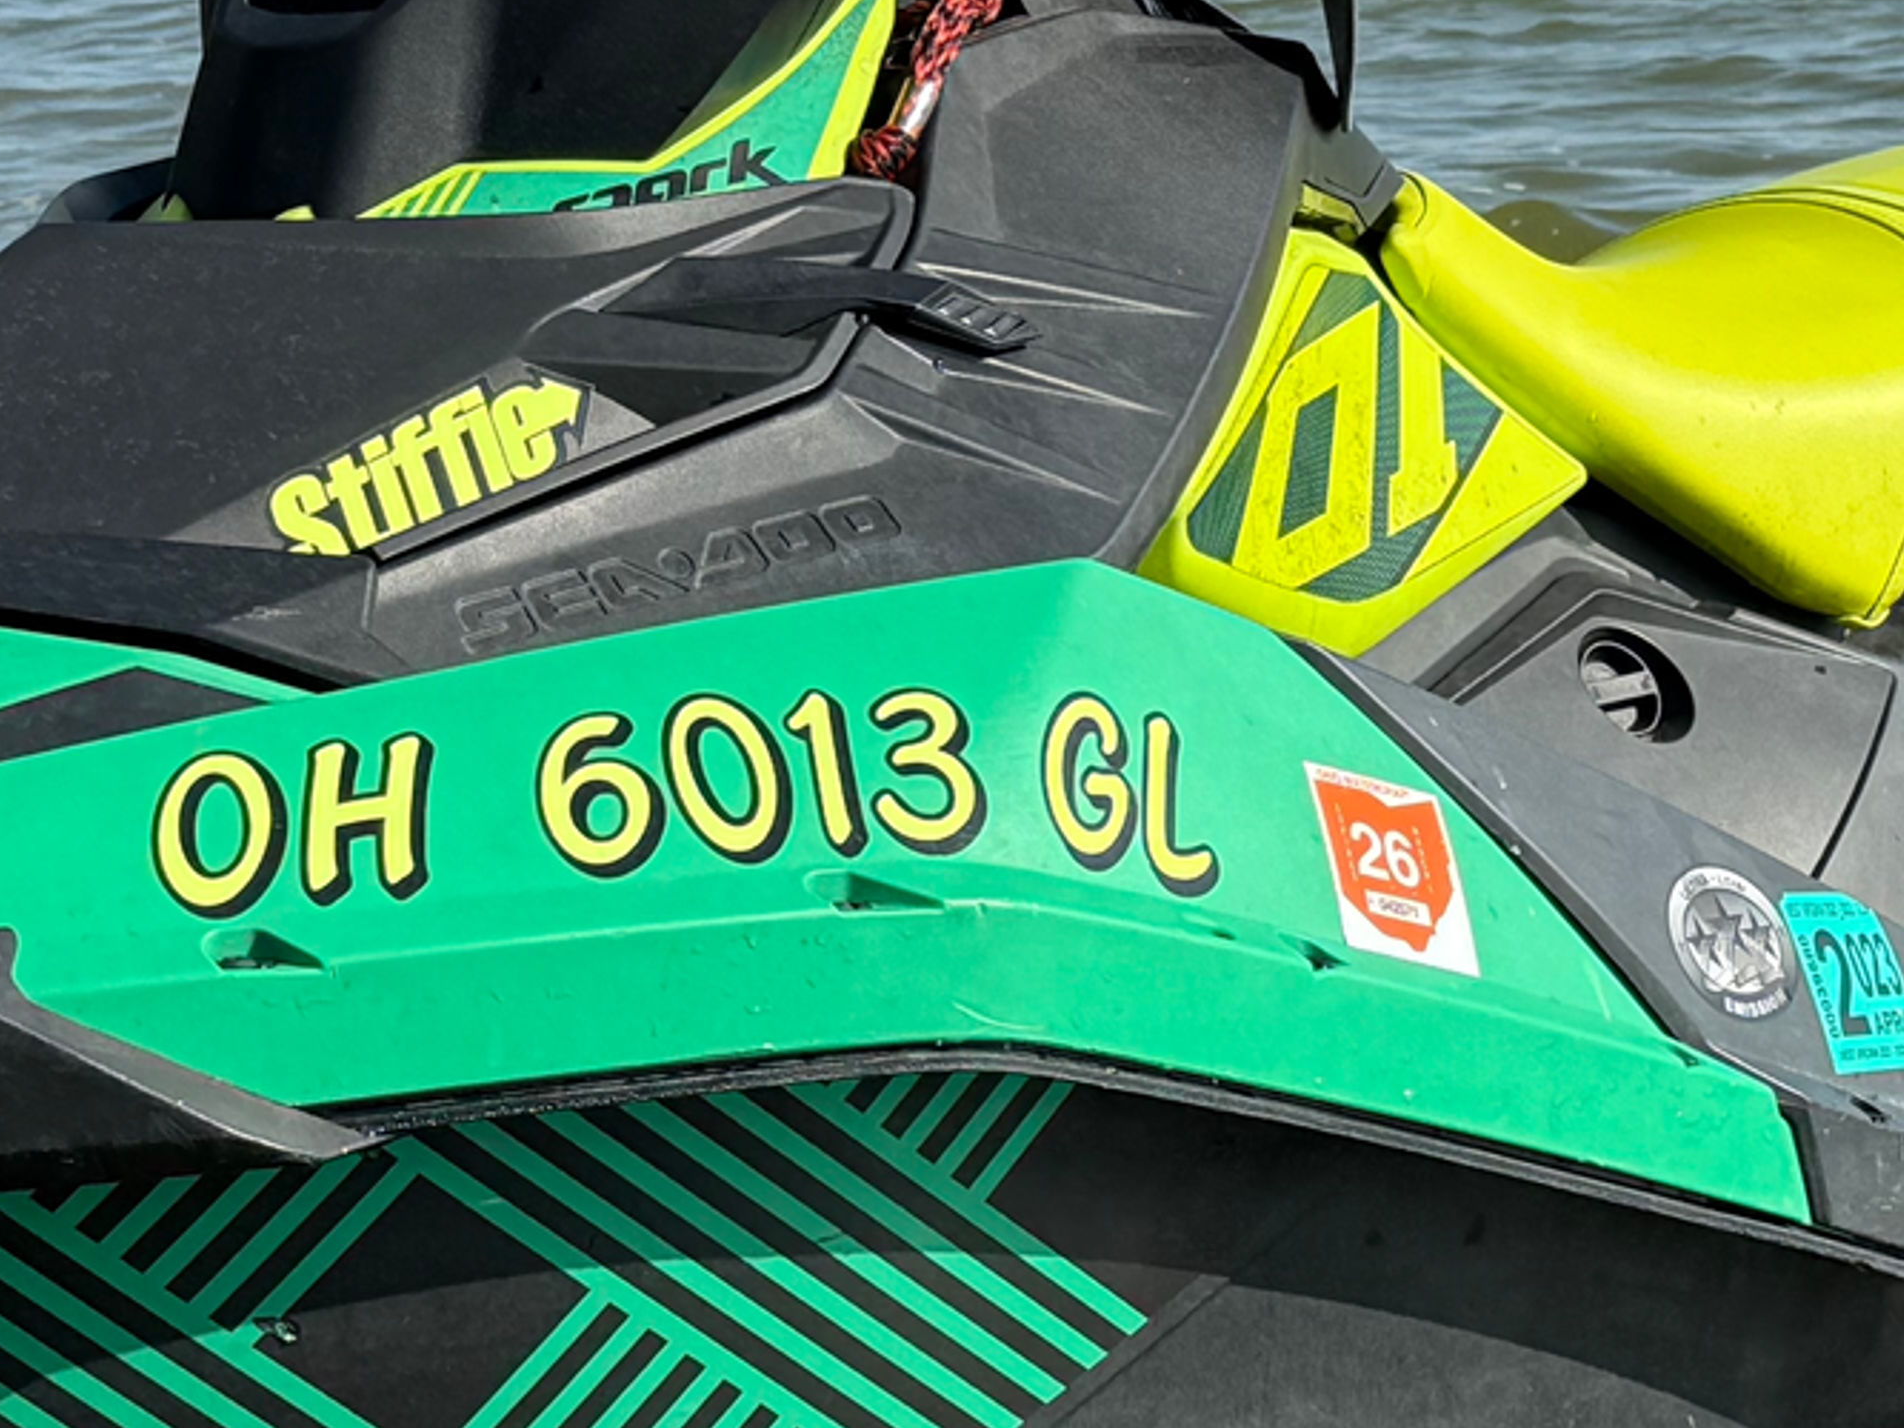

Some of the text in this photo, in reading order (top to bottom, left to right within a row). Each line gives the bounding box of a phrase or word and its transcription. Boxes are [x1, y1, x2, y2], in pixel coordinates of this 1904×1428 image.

[270, 377, 582, 555] Stiffie
[152, 730, 431, 918] OH
[536, 688, 986, 878] 6013
[1040, 691, 1219, 896] GL
[1349, 822, 1422, 889] 26
